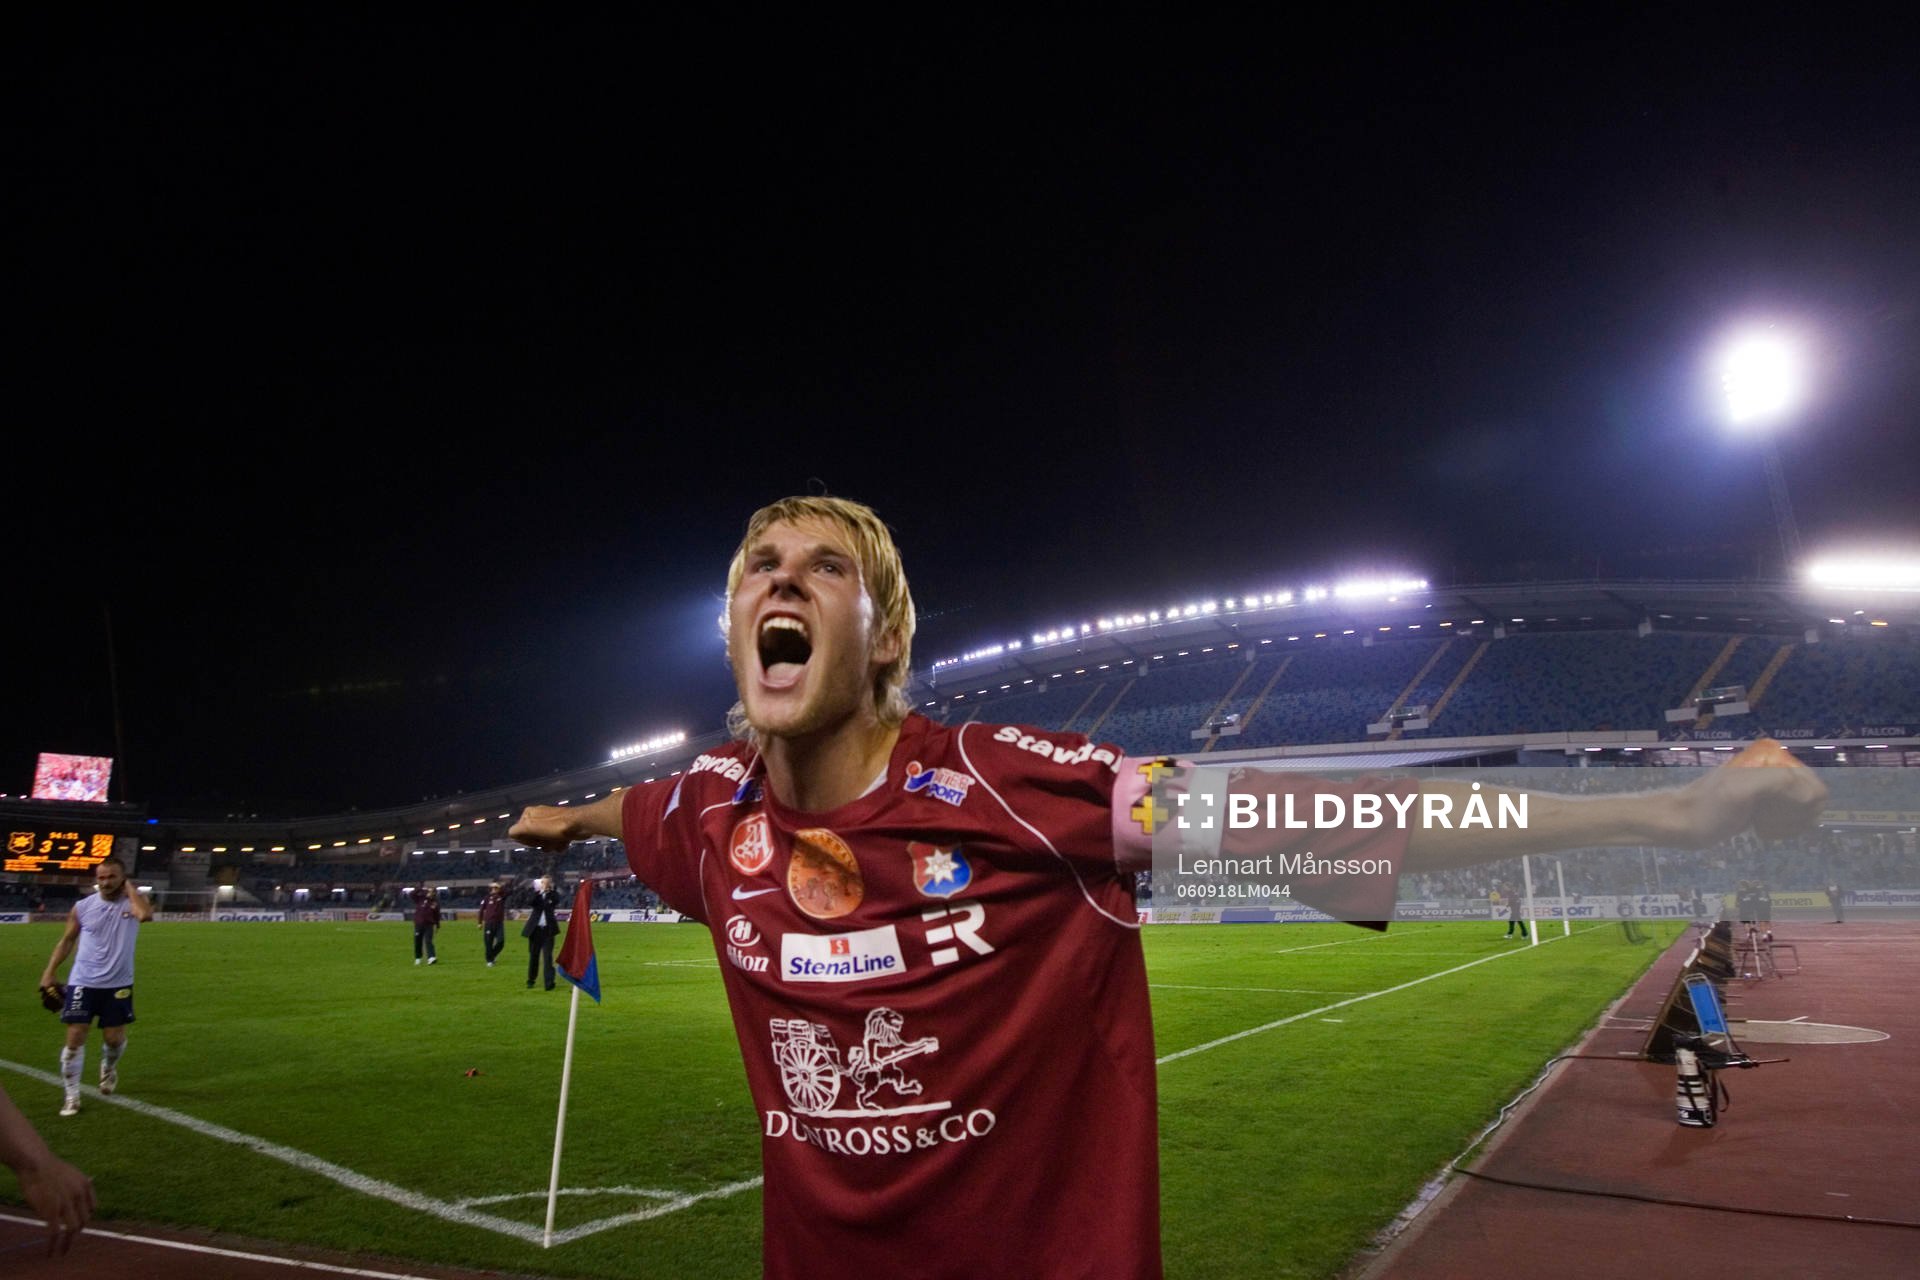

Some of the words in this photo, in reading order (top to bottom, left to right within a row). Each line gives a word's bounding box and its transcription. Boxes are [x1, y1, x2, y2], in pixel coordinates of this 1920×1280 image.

[1774, 729, 1814, 738] FALCON
[1861, 727, 1906, 737] FALCON
[993, 726, 1123, 773] Stavdal
[39, 840, 54, 853] 3
[72, 841, 86, 854] 2
